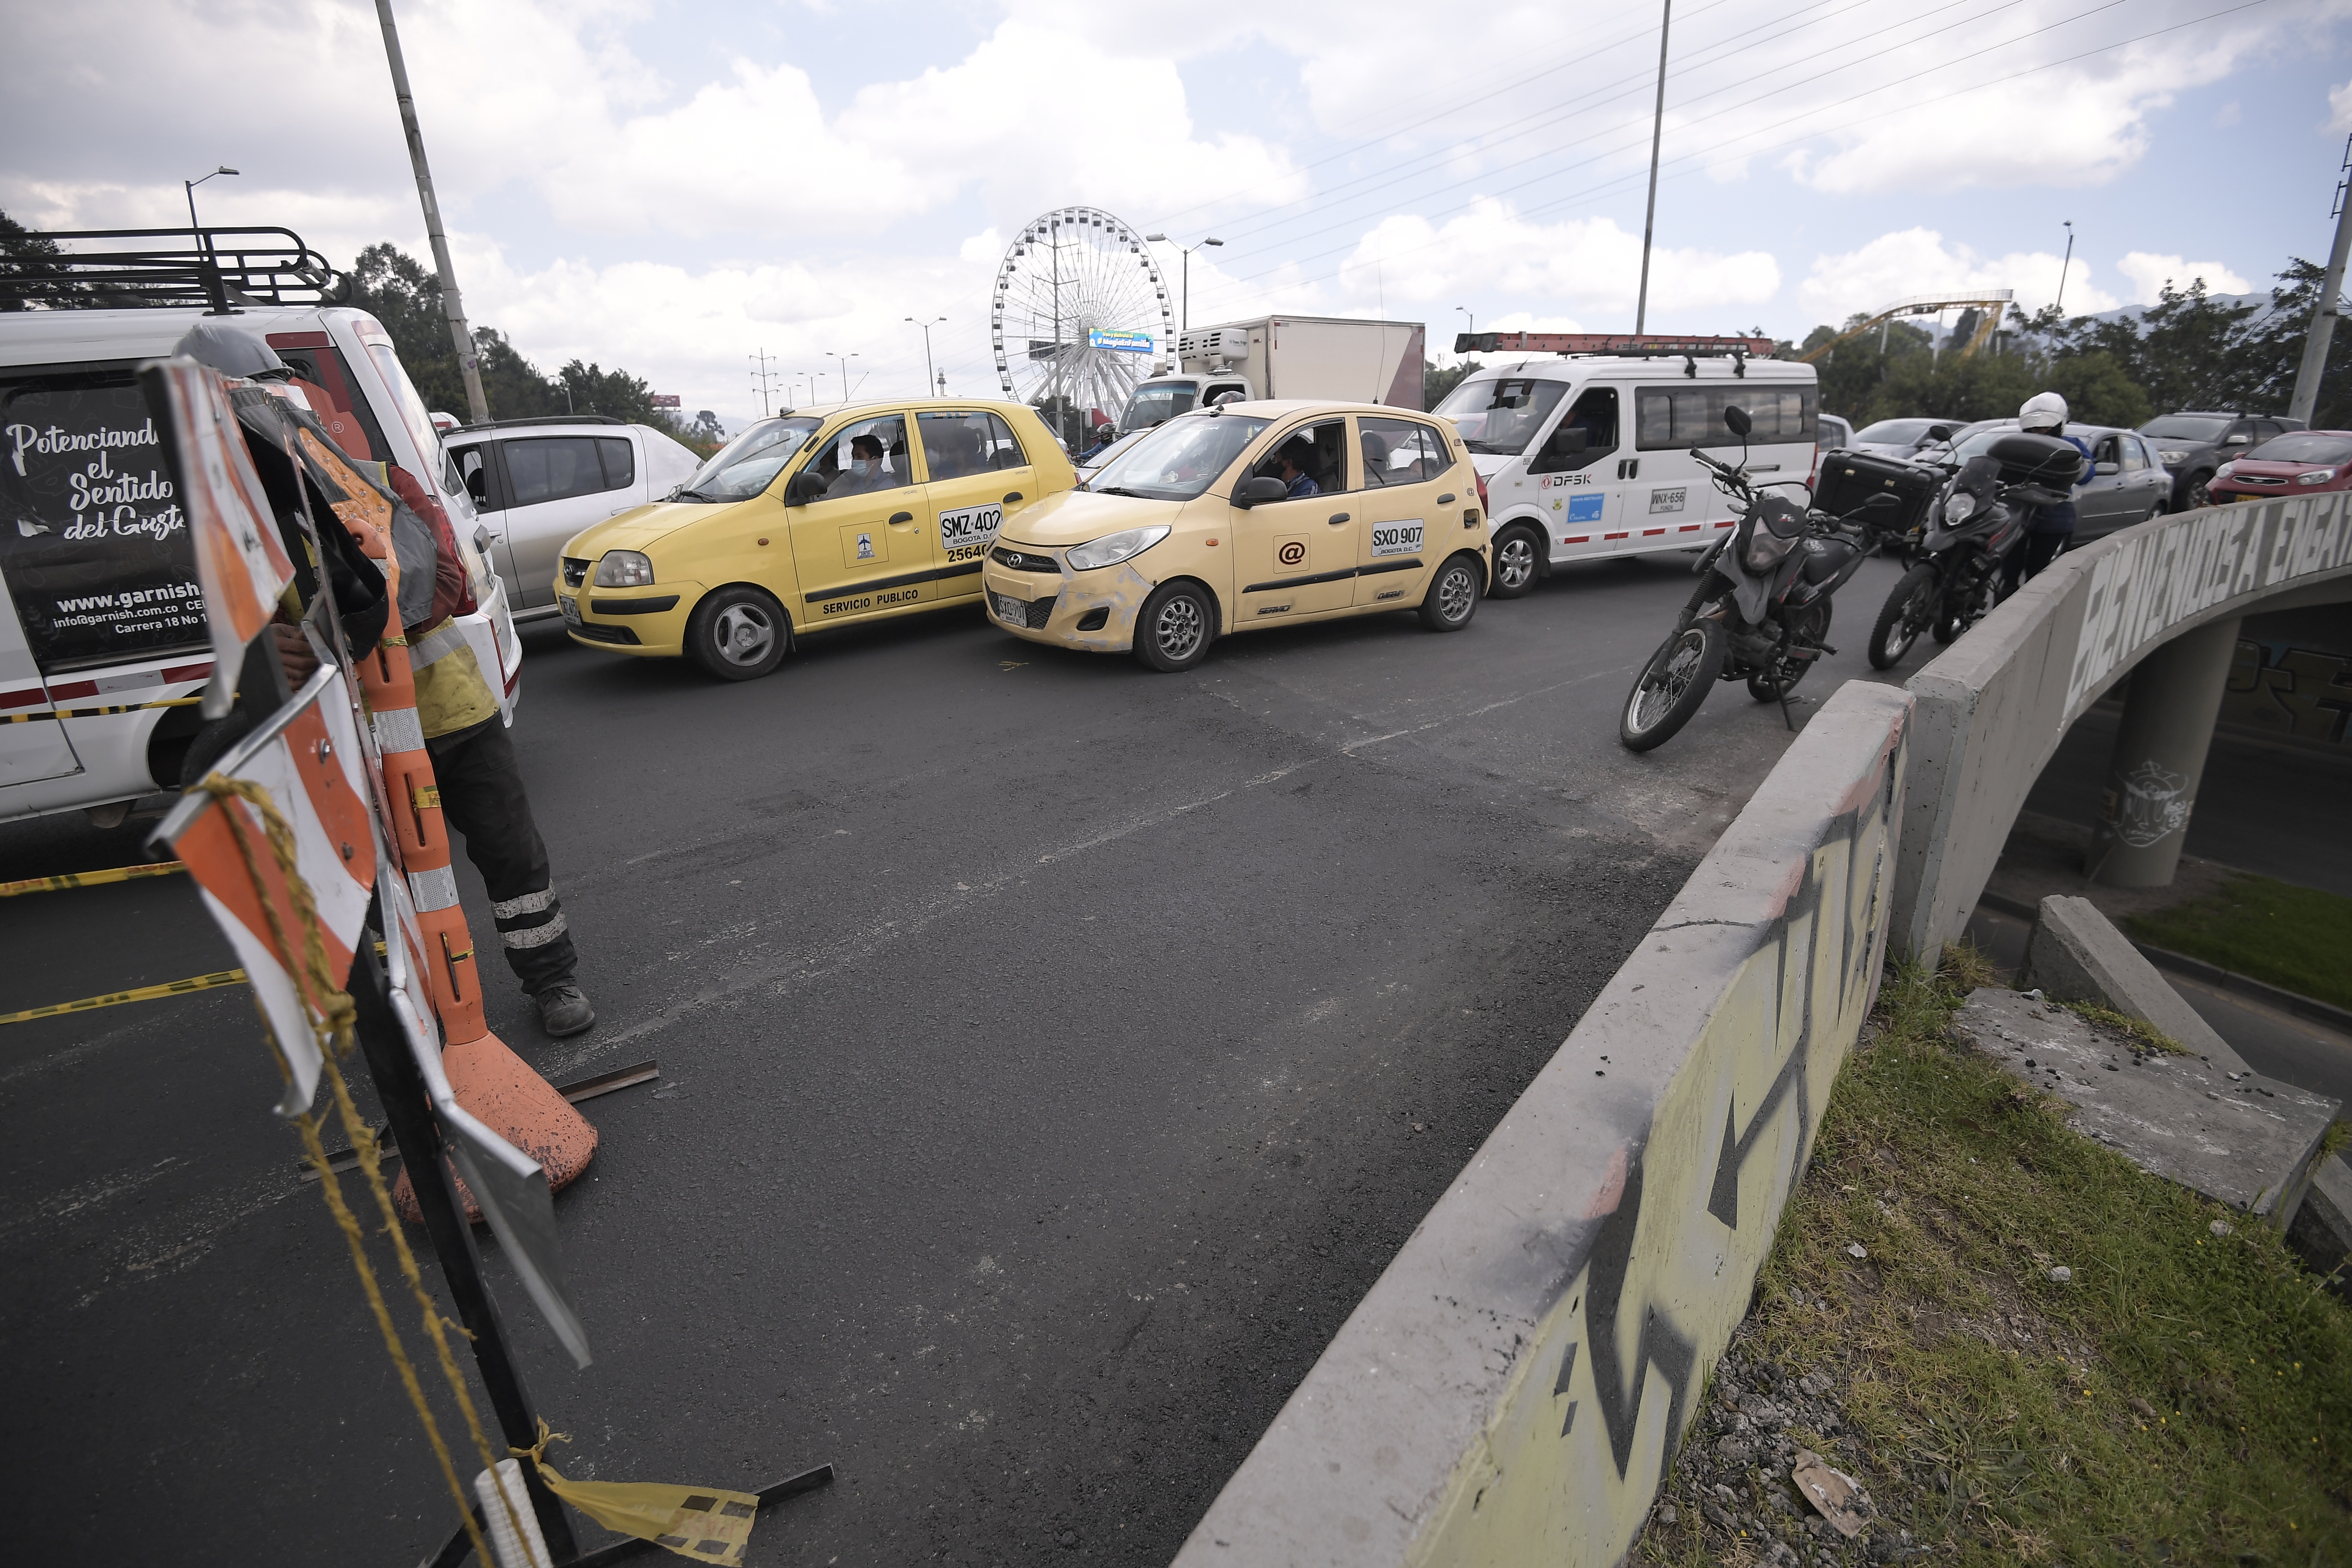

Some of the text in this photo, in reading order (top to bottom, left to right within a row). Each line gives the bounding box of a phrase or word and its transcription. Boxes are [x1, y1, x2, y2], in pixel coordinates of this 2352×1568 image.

[88, 450, 114, 479] el
[70, 470, 174, 510] Sentido
[1553, 474, 1592, 487] DFSK
[63, 511, 109, 540] del
[1373, 526, 1423, 546] SXO 907
[953, 535, 982, 544] BOGOTA
[2235, 506, 2267, 596] A
[823, 589, 918, 615] SERVICIO PUBLICO
[53, 605, 179, 628] info@garnish.com.co
[115, 621, 163, 634] Carrera
[165, 616, 180, 627] 18
[182, 615, 198, 626] No
